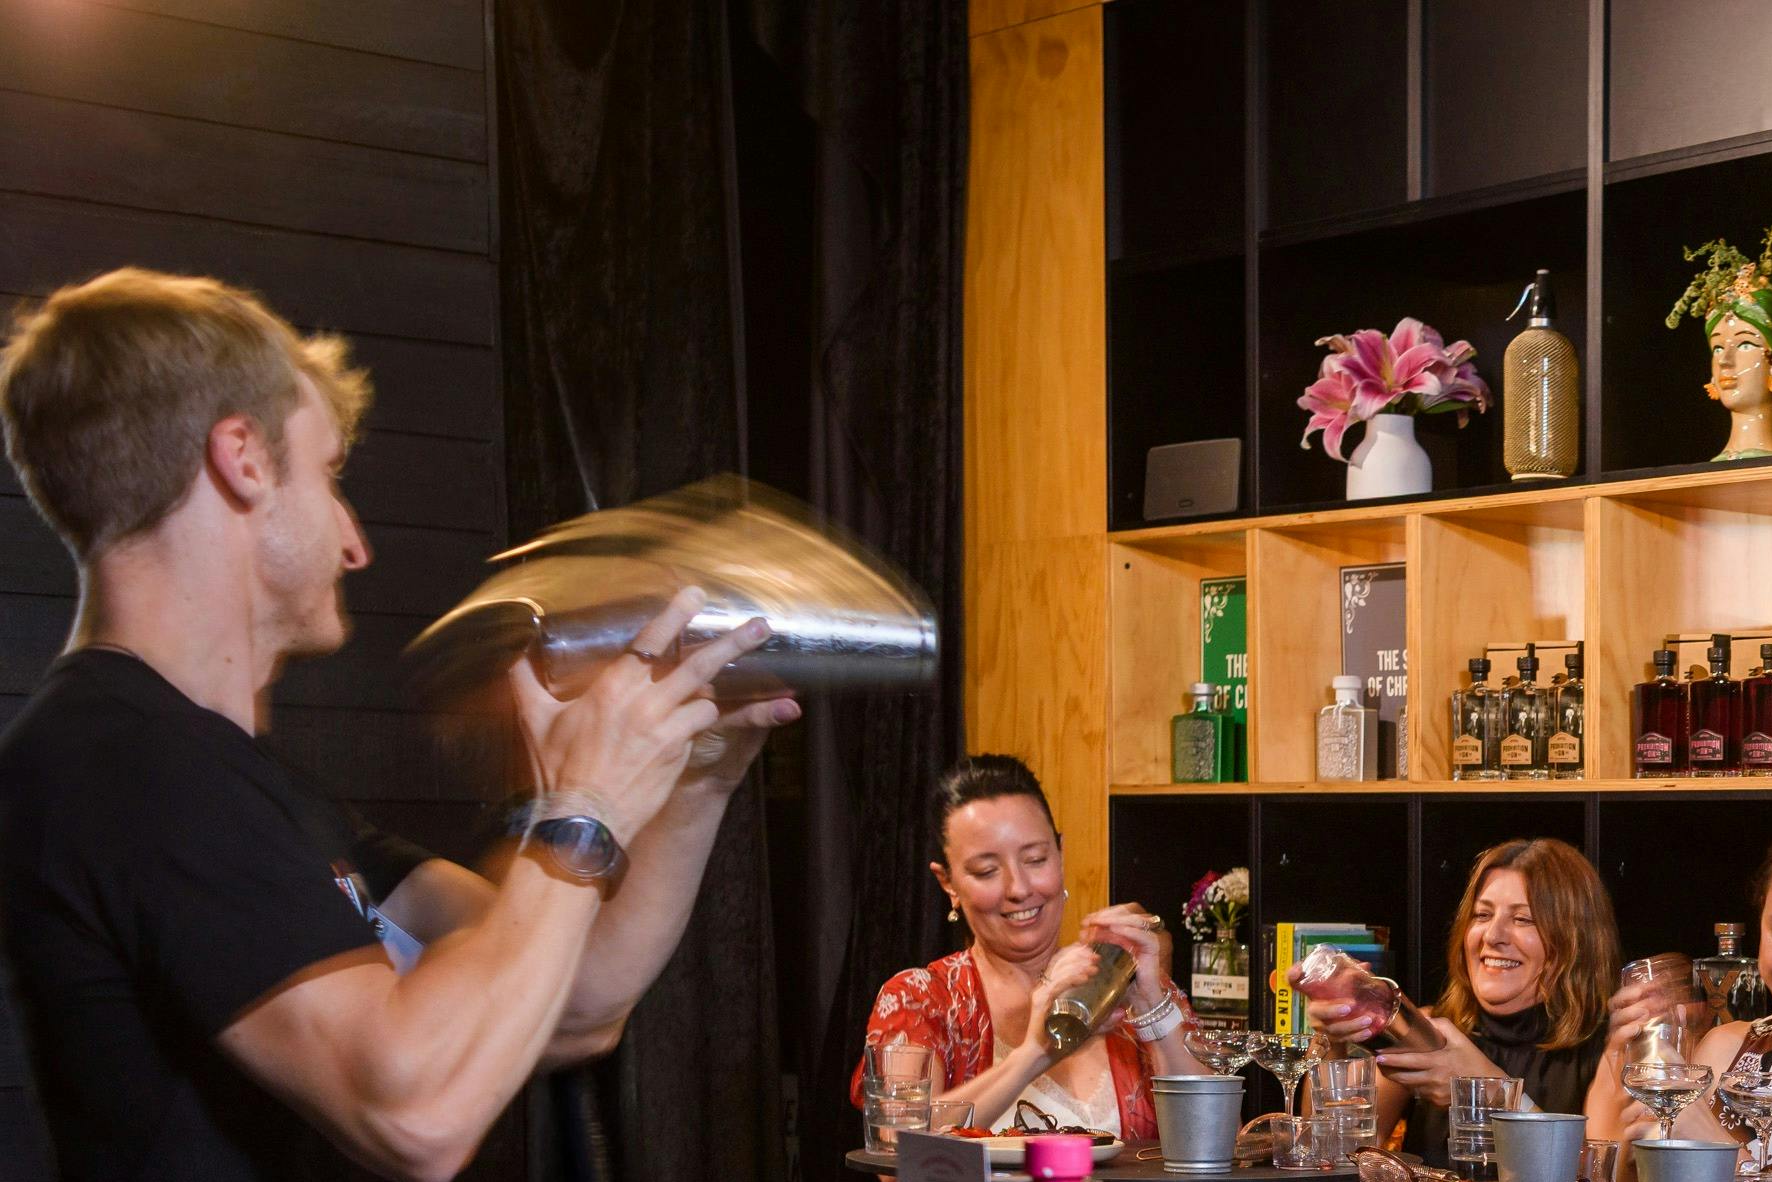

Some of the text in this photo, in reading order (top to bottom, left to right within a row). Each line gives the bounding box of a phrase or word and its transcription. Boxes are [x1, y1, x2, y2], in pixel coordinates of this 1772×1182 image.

[1377, 650, 1399, 670] THE
[1214, 684, 1230, 709] OF
[1367, 676, 1383, 698] OF
[1278, 988, 1289, 1014] GIN
